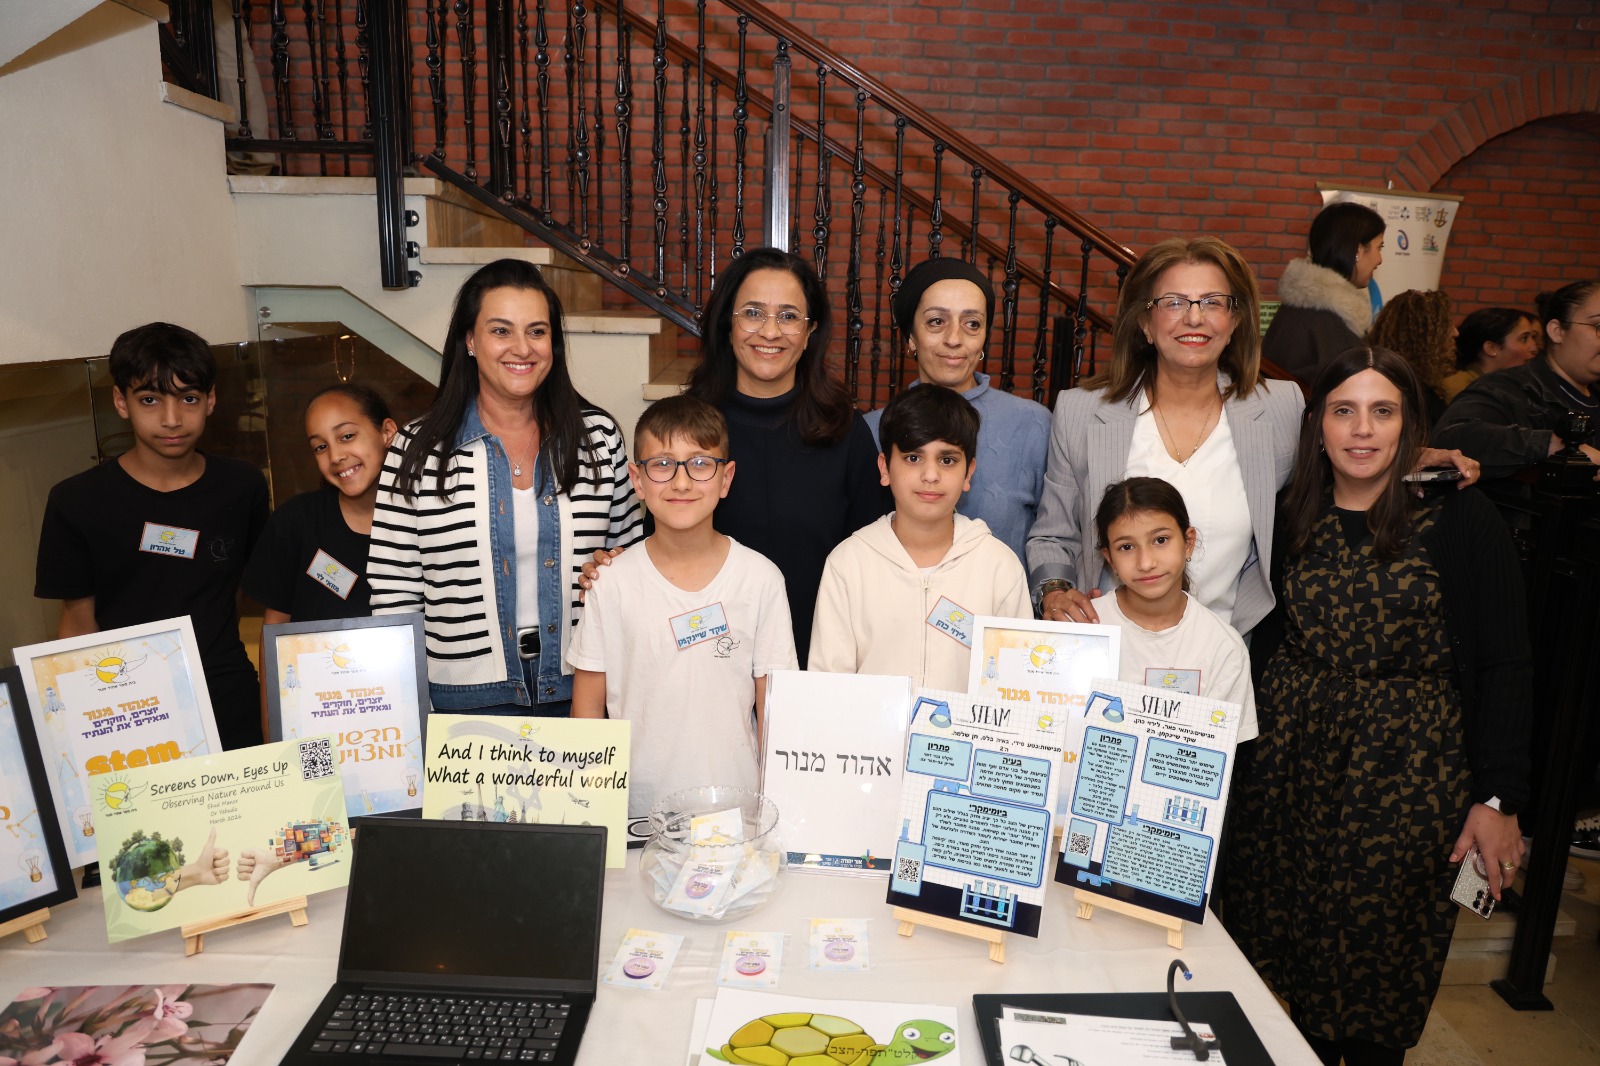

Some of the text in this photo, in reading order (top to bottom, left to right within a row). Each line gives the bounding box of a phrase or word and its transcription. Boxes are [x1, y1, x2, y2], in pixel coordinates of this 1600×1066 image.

[709, 624, 727, 635] שקד
[936, 620, 949, 630] כהן
[678, 631, 706, 647] שיינקמן
[951, 628, 966, 640] לירוי
[315, 686, 385, 701] באהוד מנור
[998, 687, 1086, 706] באהוד מנור
[83, 696, 160, 720] באהוד מנור
[322, 697, 382, 709] יוצרים, חוקרים
[359, 704, 391, 713] ומאירים
[1140, 695, 1181, 718] STEAM
[93, 706, 158, 728] יוצרים, חוקרים
[311, 710, 339, 718] העתיד
[970, 704, 1011, 727] STEAM
[82, 712, 169, 738] ומאירים את העתיד
[1100, 734, 1122, 745] פתרון
[927, 742, 949, 753] פתרון
[1177, 748, 1197, 758] בעיה
[438, 742, 616, 769] And I think to myself
[775, 749, 826, 772] מנור
[1001, 756, 1022, 766] בעיה
[836, 754, 891, 776] אהוד
[150, 761, 288, 796] Screens Down, Eyes Up
[427, 766, 627, 789] What a wonderful world
[162, 779, 284, 810] Observing Nature Around Us
[969, 804, 1008, 817] ביומימקרי
[1142, 824, 1180, 839] ביומימקרי
